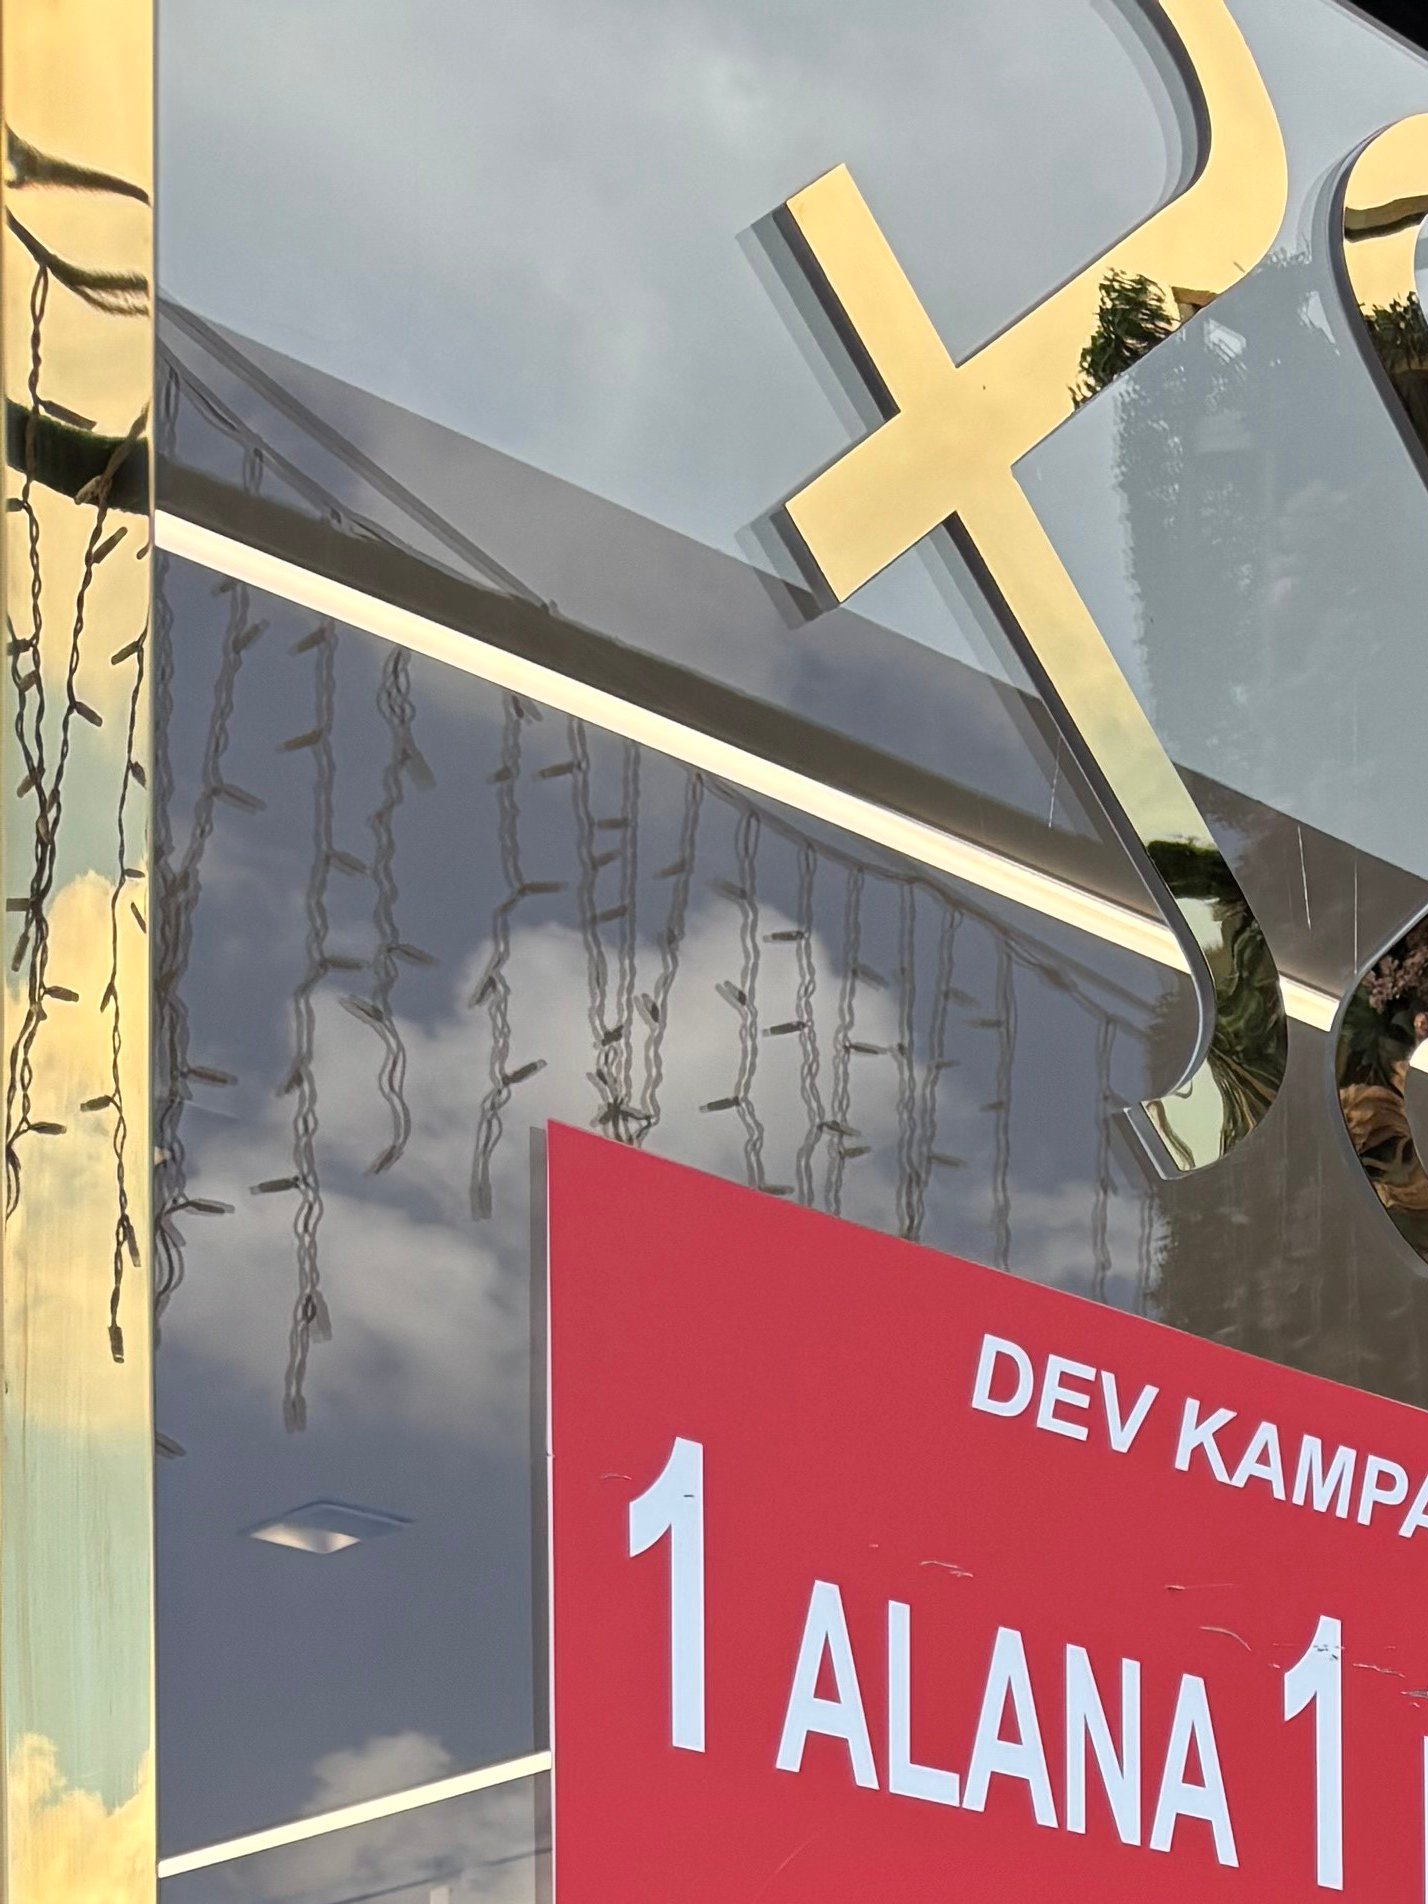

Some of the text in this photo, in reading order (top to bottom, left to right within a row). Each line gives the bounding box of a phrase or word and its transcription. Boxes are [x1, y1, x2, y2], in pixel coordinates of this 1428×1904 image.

[971, 1333, 1160, 1453] DEV
[628, 1436, 706, 1753] 1
[775, 1579, 1239, 1868] ALANA
[1283, 1614, 1344, 1891] 1
